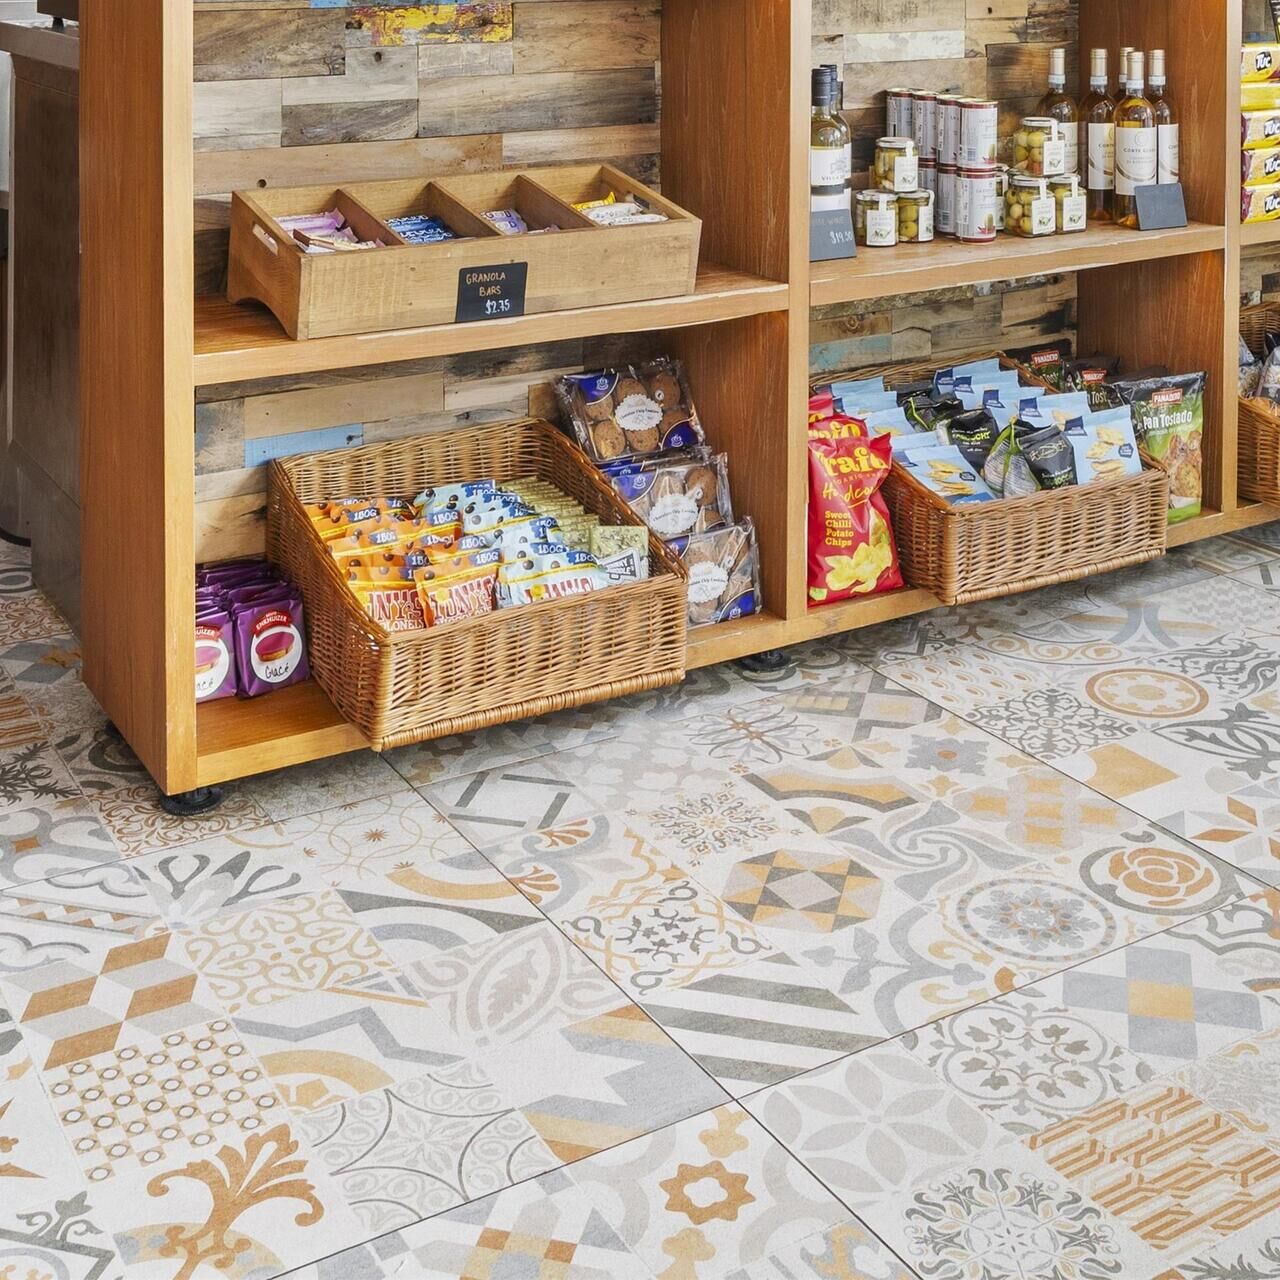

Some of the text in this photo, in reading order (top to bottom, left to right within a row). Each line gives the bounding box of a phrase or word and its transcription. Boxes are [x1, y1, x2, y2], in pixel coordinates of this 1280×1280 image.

[466, 272, 506, 284] GRANOLA
[479, 286, 502, 297] BARS
[485, 299, 510, 314] $2.75
[1144, 411, 1193, 430] Pan Tostado
[354, 509, 377, 521] 150G
[433, 511, 458, 525] 150G
[825, 520, 852, 528] Chilli
[826, 528, 854, 537] Potato
[825, 538, 852, 548] Chips
[475, 551, 498, 564] 150G
[265, 662, 289, 678] Glacé
